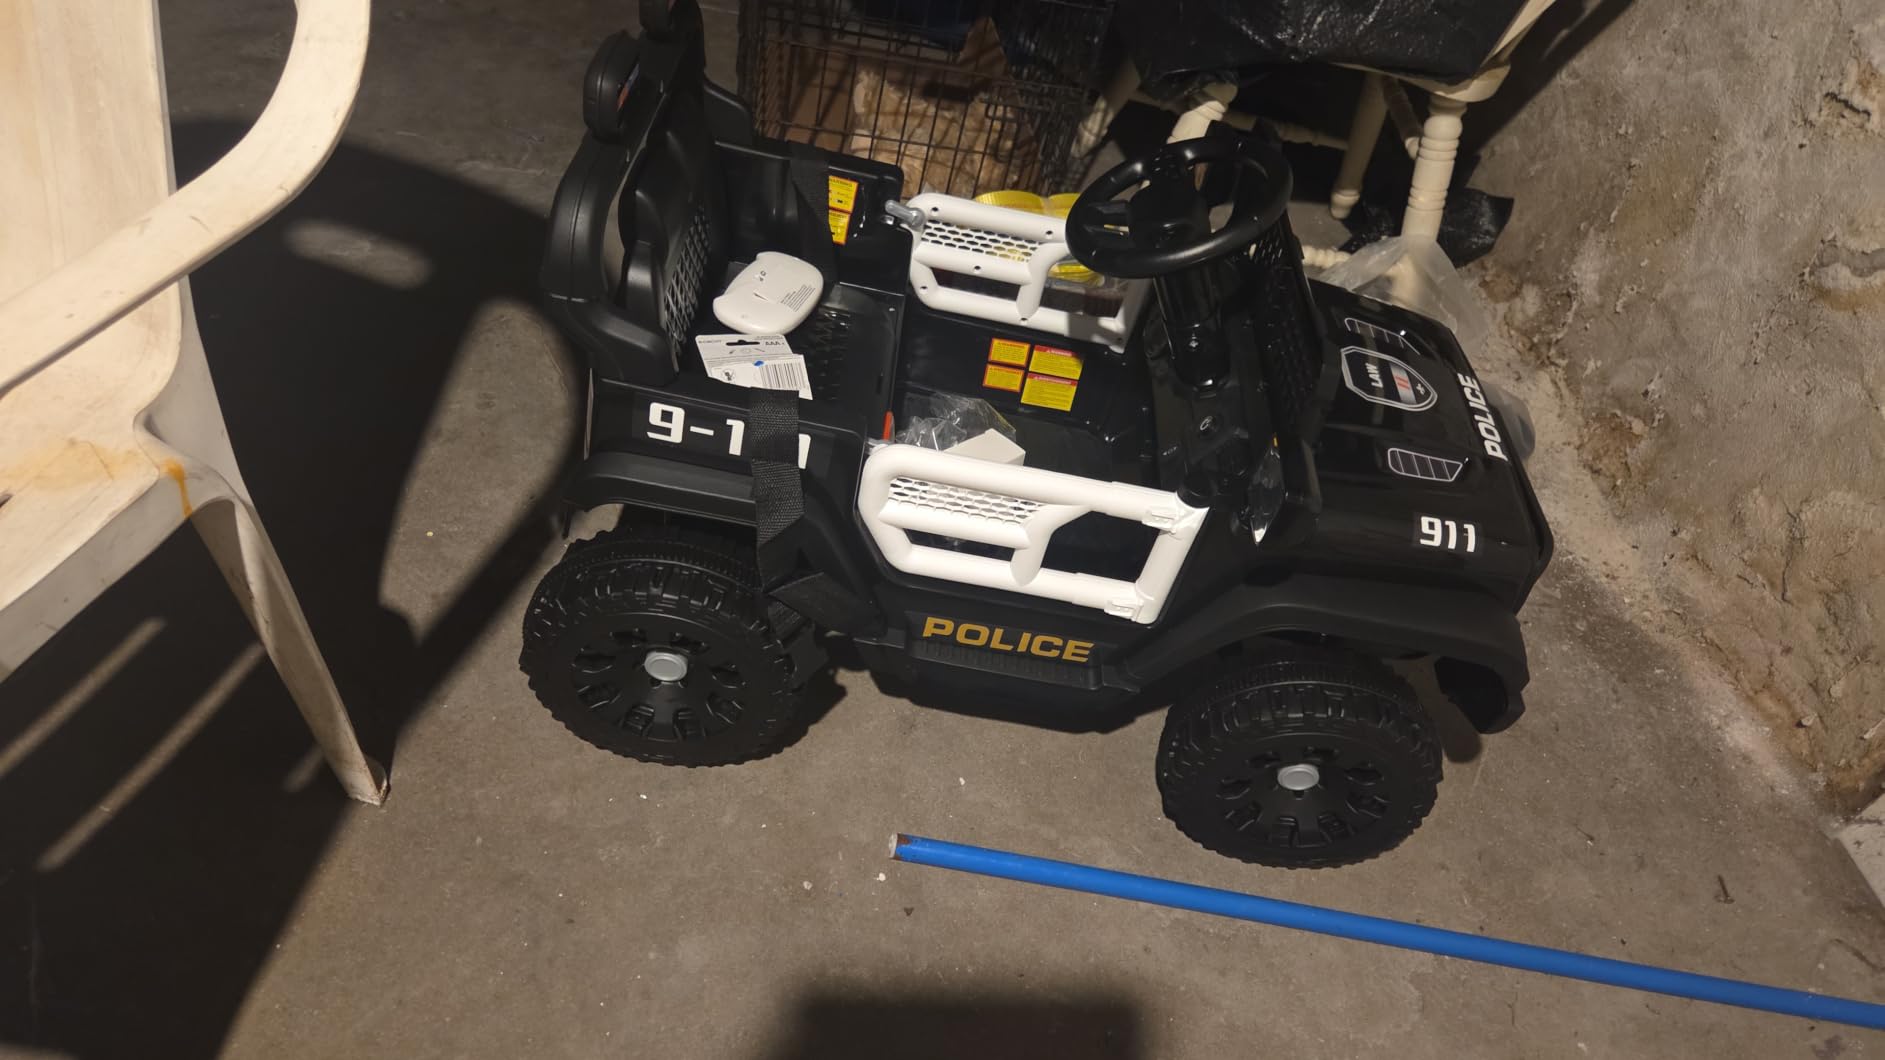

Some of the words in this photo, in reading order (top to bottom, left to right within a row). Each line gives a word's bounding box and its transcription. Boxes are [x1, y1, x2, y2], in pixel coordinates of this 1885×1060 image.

[1365, 362, 1383, 388] LAW
[1457, 373, 1508, 462] POLICE
[1419, 515, 1476, 553] 911
[922, 616, 1095, 663] POLICE
